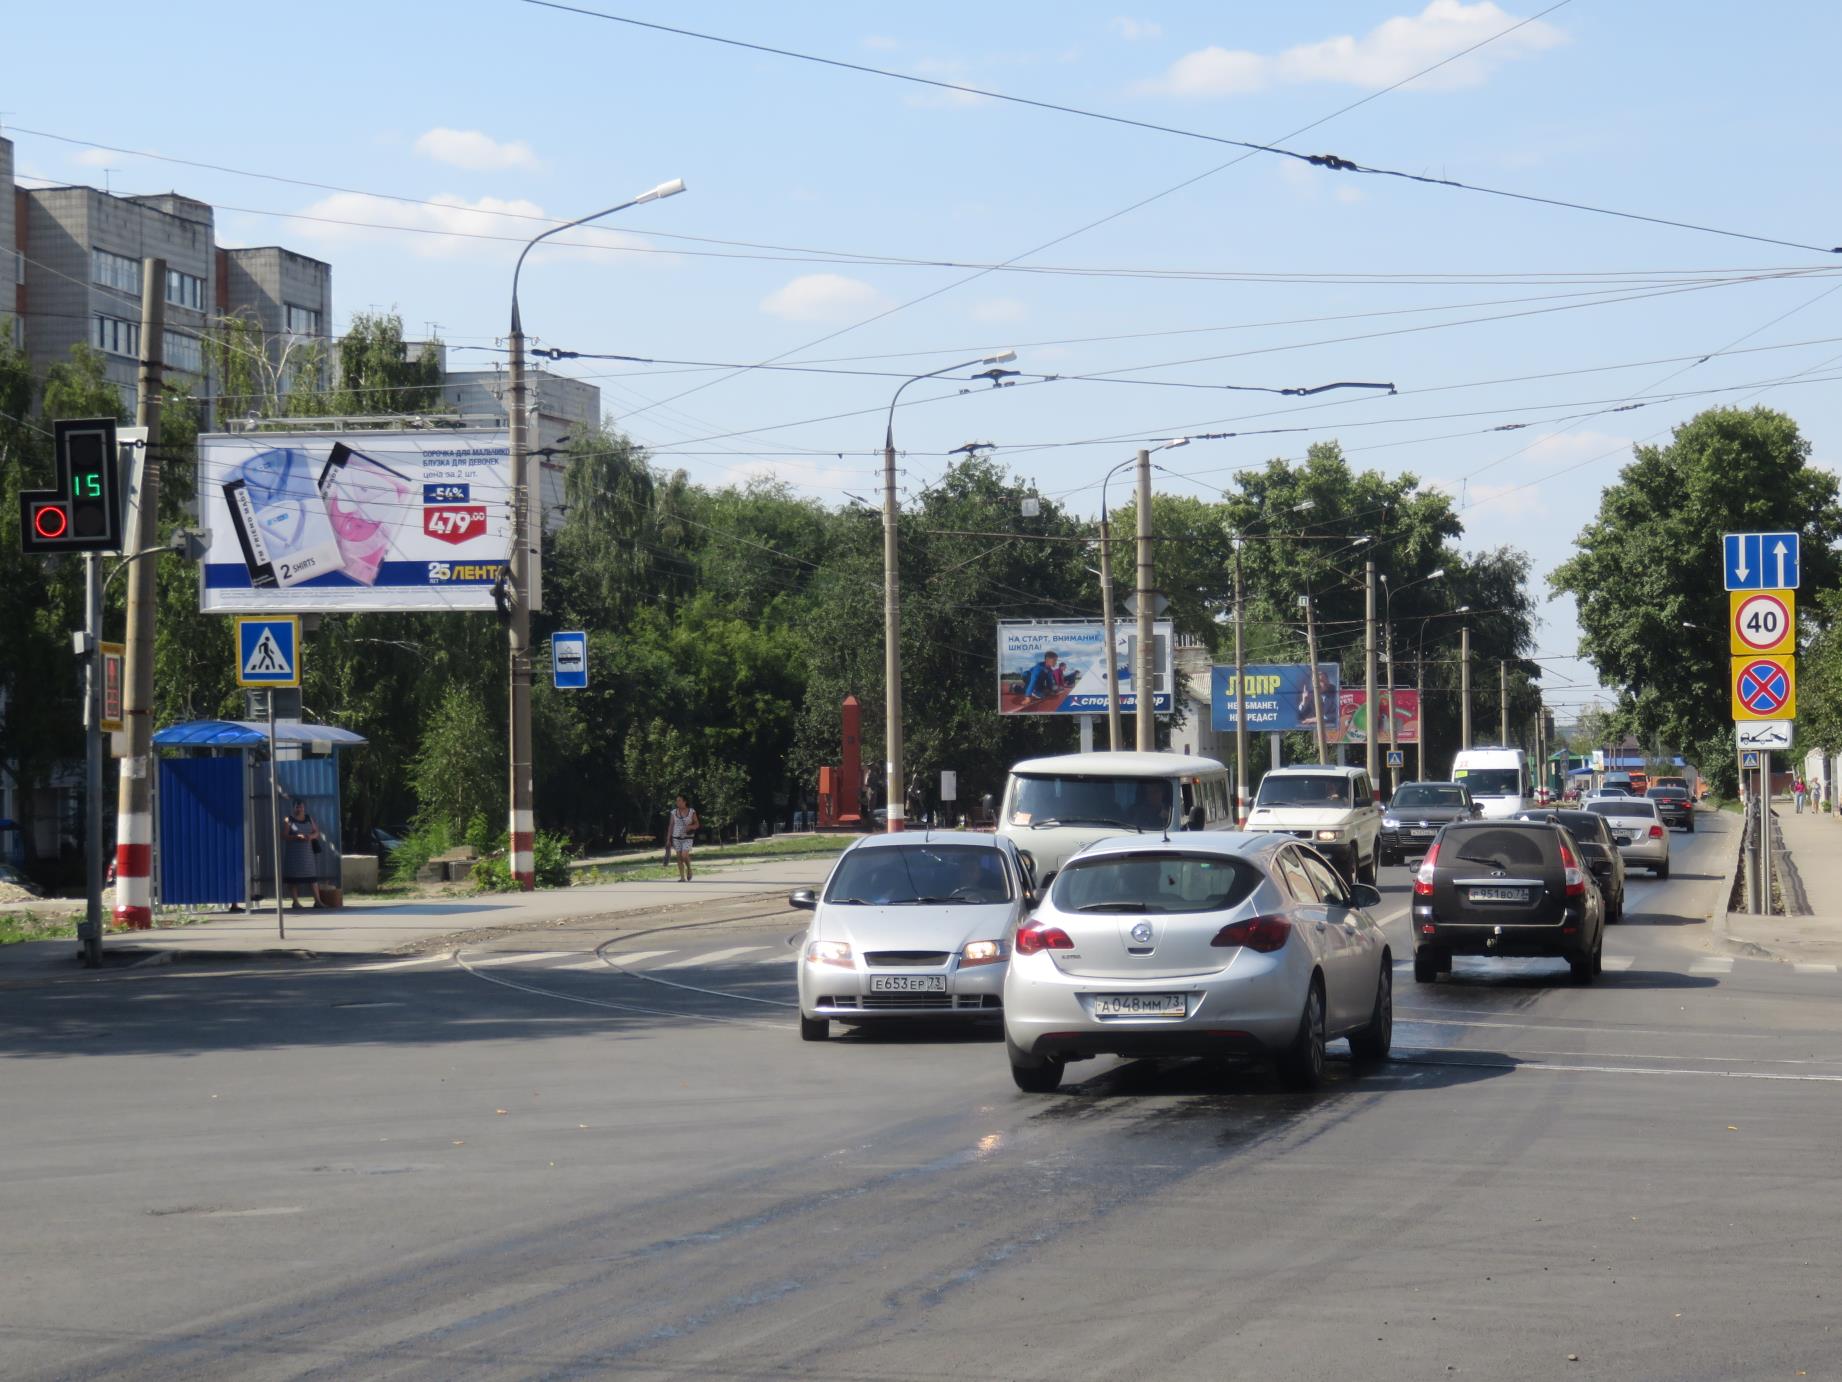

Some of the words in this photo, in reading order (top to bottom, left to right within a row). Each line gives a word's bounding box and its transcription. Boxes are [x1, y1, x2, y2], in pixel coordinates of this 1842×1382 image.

[473, 448, 510, 456] МАЛЬЧИКО
[423, 459, 450, 467] БЛУЗКА
[452, 459, 467, 467] ДЛЯ
[469, 458, 499, 466] ДЕВОЧЕК
[75, 474, 100, 496] 15
[280, 564, 292, 579] 2
[293, 557, 316, 573] SHIRTS
[452, 566, 502, 580] ЛЕНТ
[1747, 611, 1777, 633] 40
[1022, 635, 1051, 643] СТАРТ,
[1226, 675, 1280, 698] ЛДПР
[1081, 696, 1164, 706] спормар
[1241, 701, 1279, 710] БМАНЕТ,
[1242, 713, 1277, 722] РЕДАСТ
